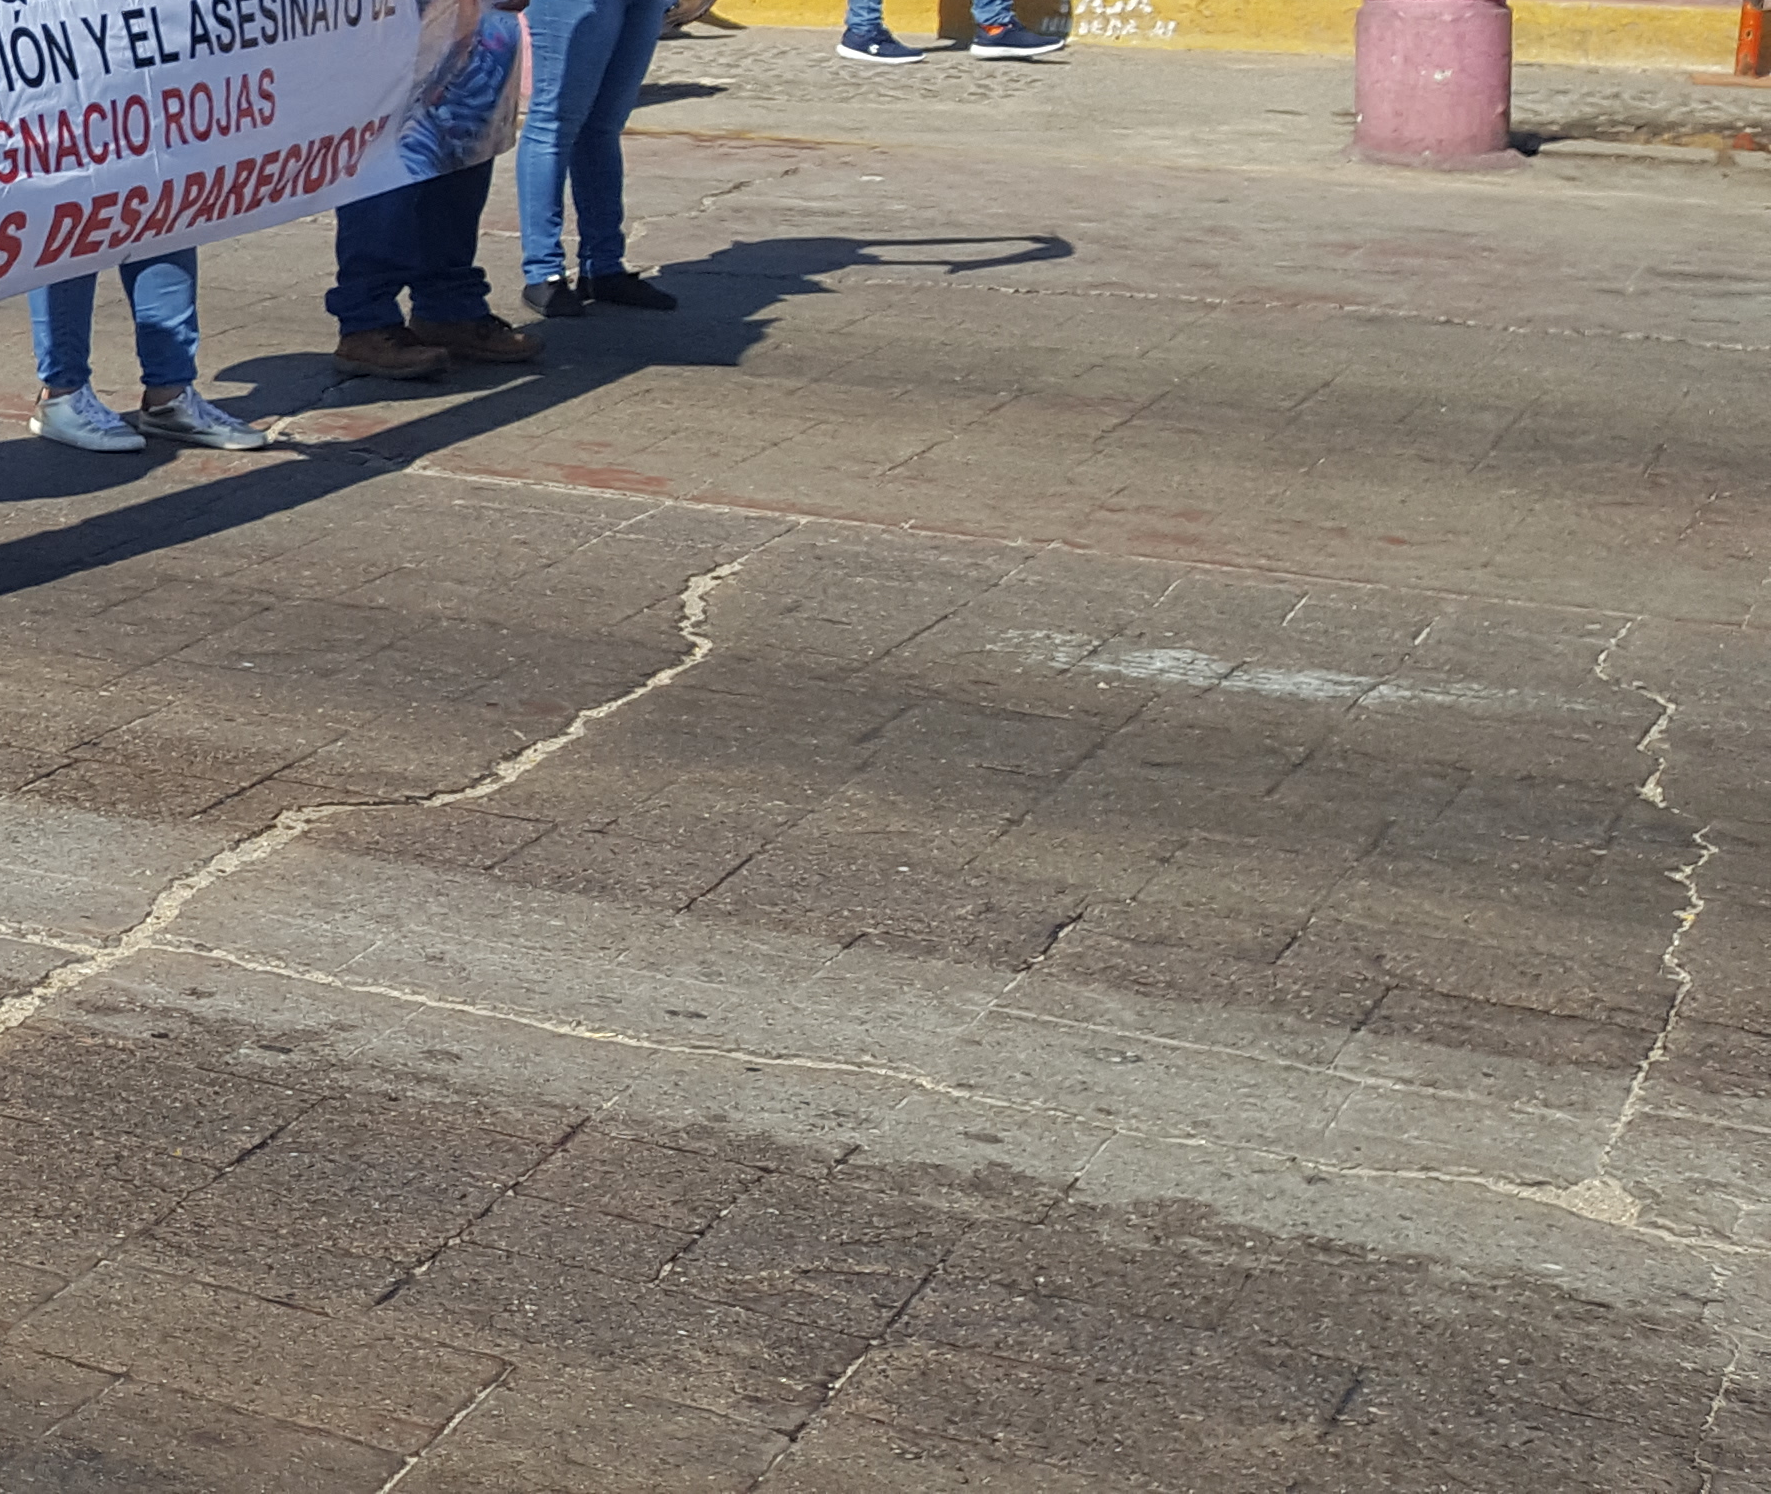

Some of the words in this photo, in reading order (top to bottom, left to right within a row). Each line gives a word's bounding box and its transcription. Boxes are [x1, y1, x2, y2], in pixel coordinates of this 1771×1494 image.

[83, 14, 113, 76] Y
[125, 5, 179, 69] EL
[162, 68, 277, 150] ROJAS
